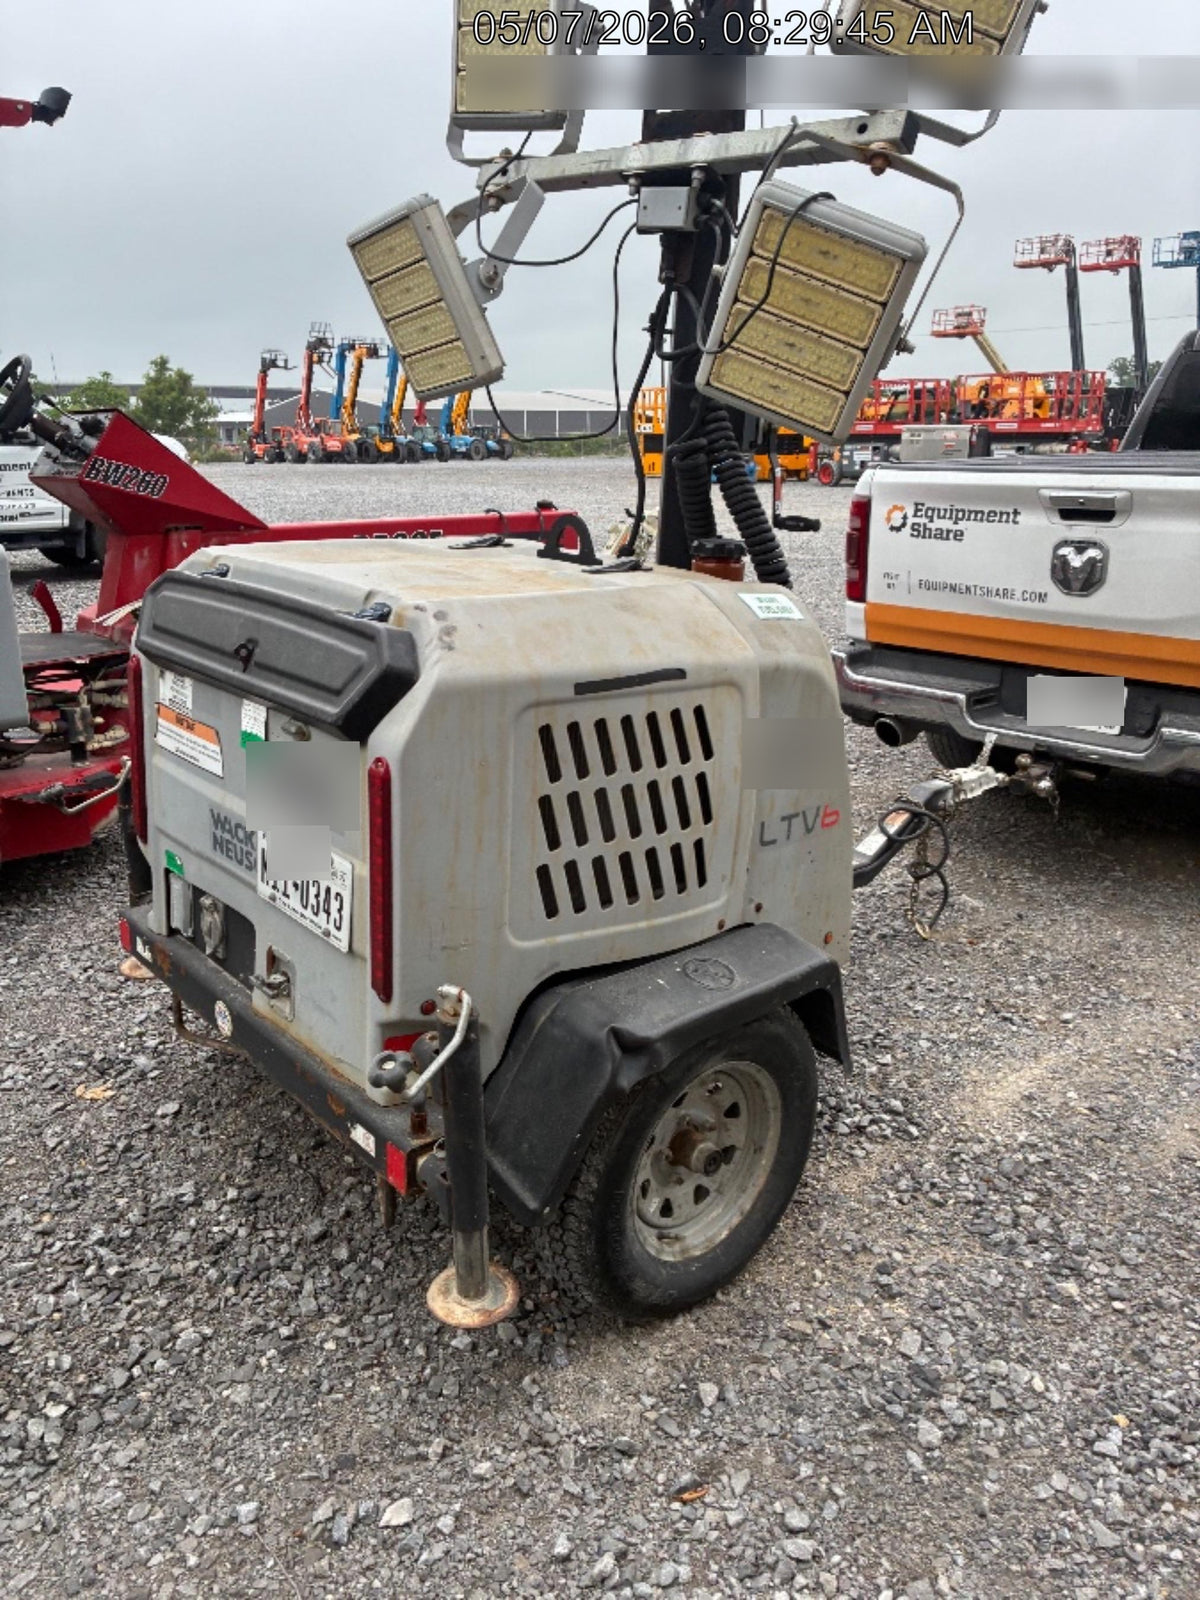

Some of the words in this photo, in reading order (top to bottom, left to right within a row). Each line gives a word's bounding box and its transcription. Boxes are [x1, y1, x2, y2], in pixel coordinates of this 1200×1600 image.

[912, 502, 1022, 525] Equipment
[909, 522, 965, 542] Share
[918, 579, 1049, 604] EQUIPMENTSHARE.COM
[212, 831, 257, 872] NEUS
